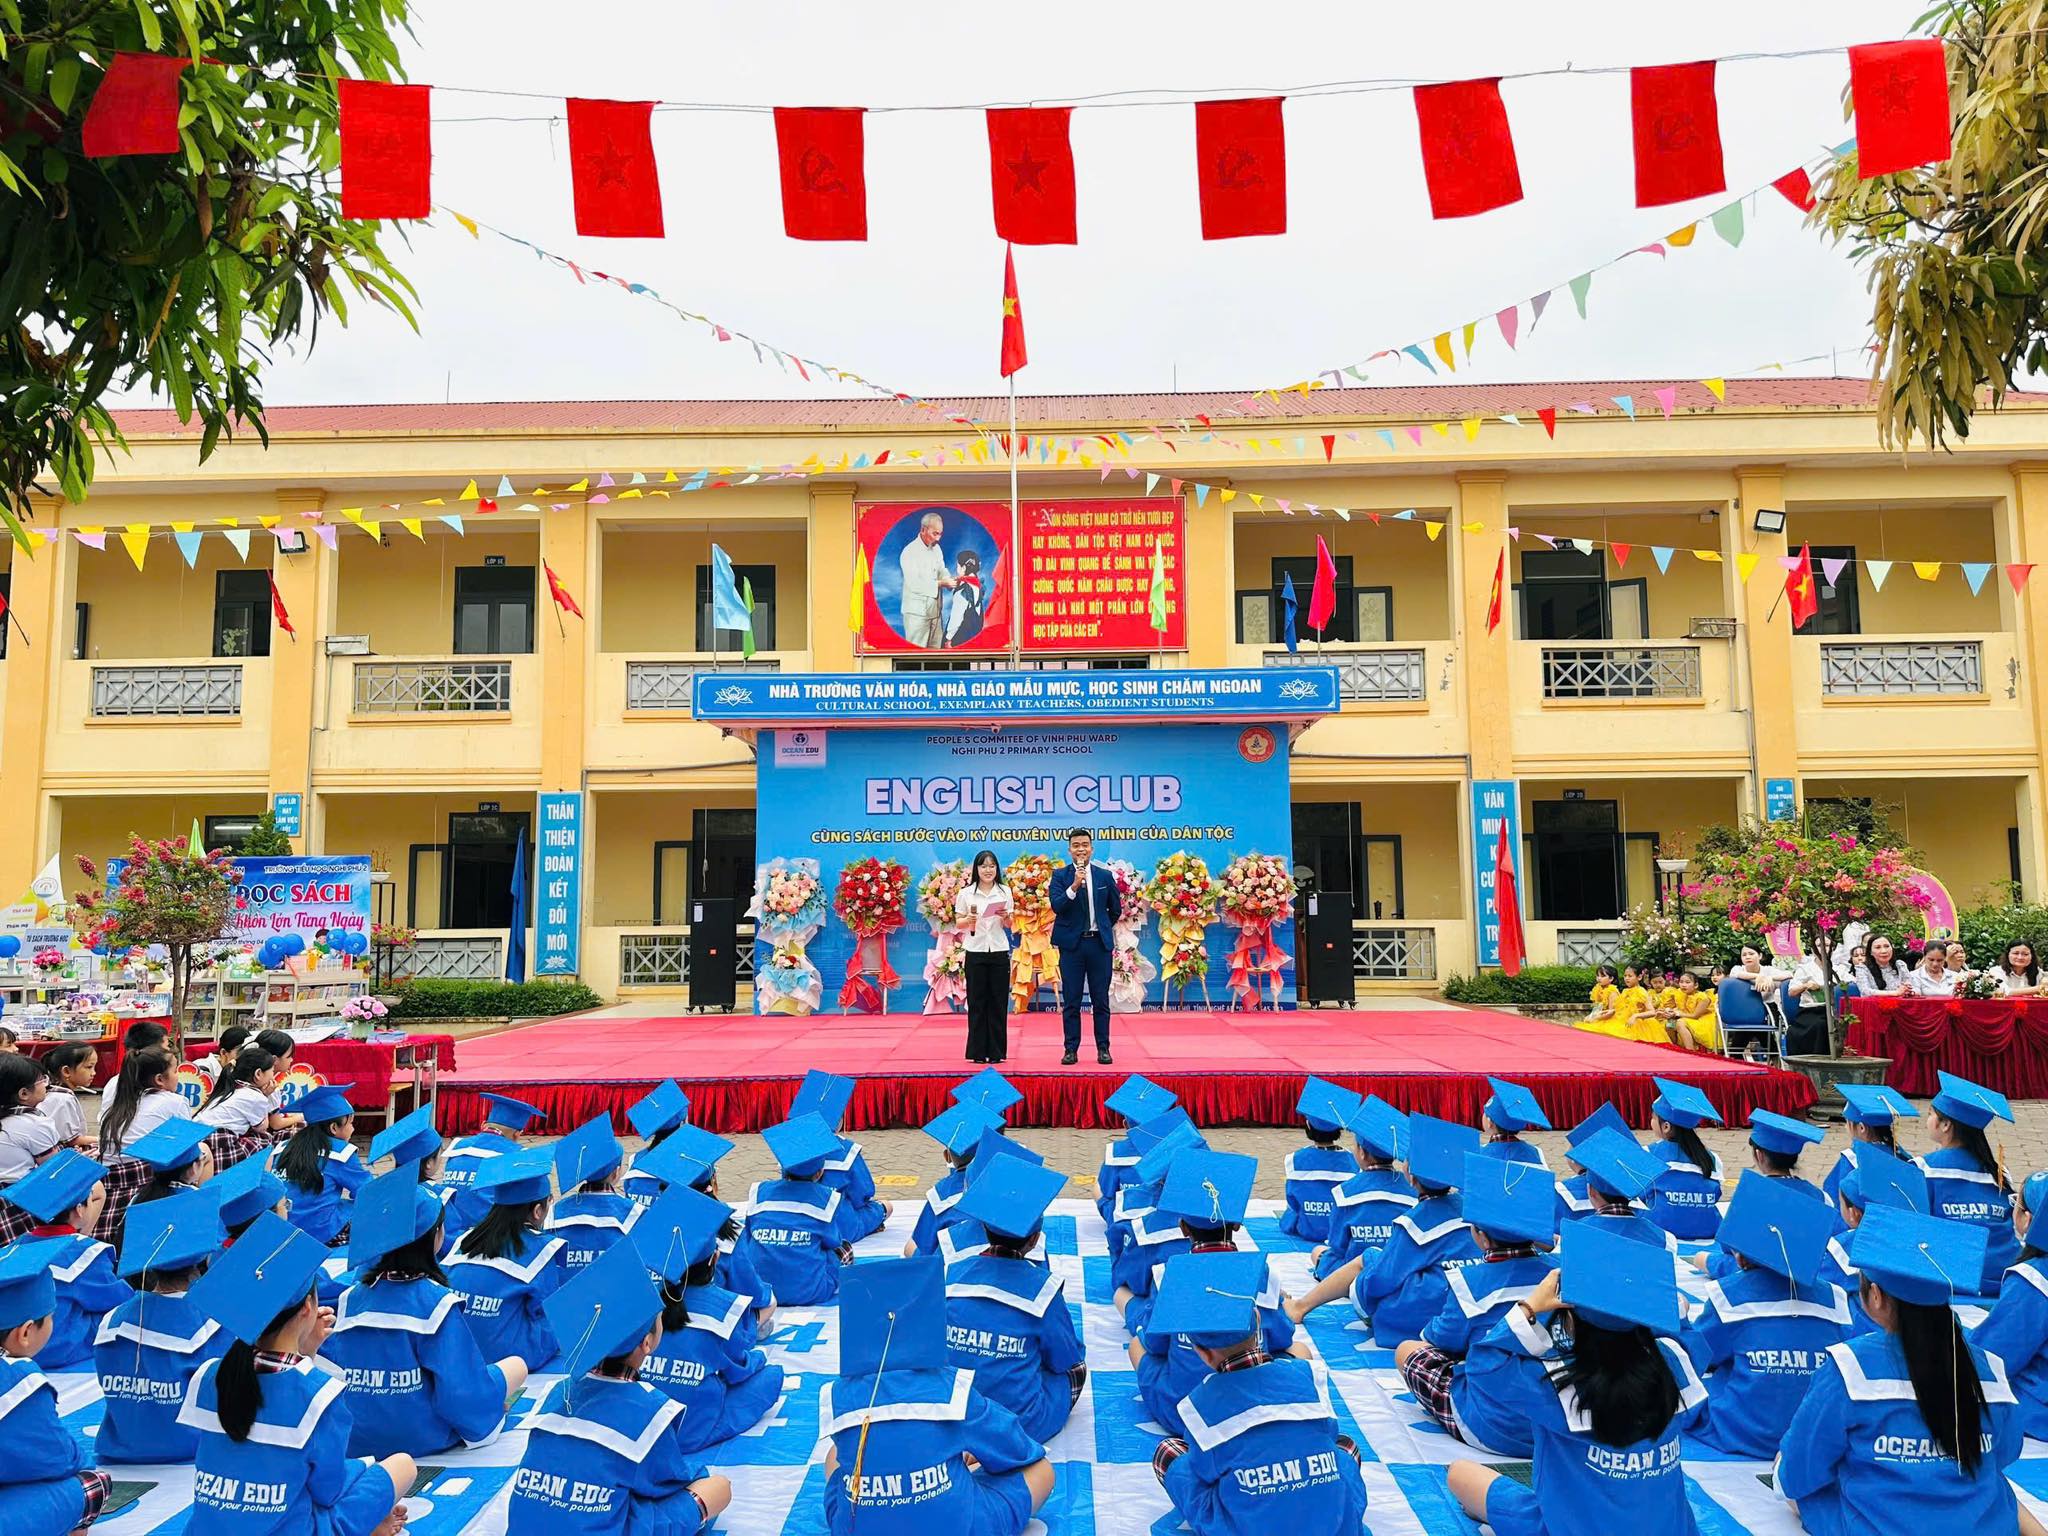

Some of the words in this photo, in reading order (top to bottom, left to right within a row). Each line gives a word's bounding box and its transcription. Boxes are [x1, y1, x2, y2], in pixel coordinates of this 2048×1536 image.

[1080, 510, 1093, 528] VIỆT
[1094, 512, 1109, 526] NAM
[1033, 535, 1045, 548] HAY
[1108, 533, 1122, 549] VIỆT
[1126, 534, 1141, 547] NAM
[1060, 557, 1075, 571] VINH
[1078, 556, 1099, 572] QUANG
[1135, 556, 1145, 569] VAI
[769, 681, 800, 698] NHÀ
[804, 681, 861, 698] TRƯỜNG
[865, 680, 895, 698] VĂN
[898, 681, 932, 699] HÓA,
[936, 680, 967, 697] NHÀ
[971, 680, 1004, 696] GIÁO
[1009, 678, 1042, 697] MẪU
[1047, 681, 1084, 700] MỰC,
[1088, 681, 1118, 699] HỌC
[1123, 681, 1158, 695] SINH
[1162, 678, 1205, 694] CHĂM
[1210, 679, 1261, 693] NGOAN
[816, 701, 881, 711] CULTURAL
[884, 701, 937, 711] SCHOOL,
[940, 700, 1013, 710] EXEMPLARY
[1017, 699, 1085, 709] TEACHERS,
[1087, 698, 1149, 708] OBEDIENT
[1151, 697, 1215, 707] STUDENTS
[927, 736, 971, 744] PEOPLE'S
[973, 735, 1024, 744] COMMITEE
[1026, 735, 1039, 743] OF
[1041, 734, 1065, 743] VINH
[1067, 734, 1086, 743] PHU
[1087, 734, 1118, 742] WARD
[951, 747, 976, 755] NGHI
[978, 746, 997, 755] PHU
[1000, 746, 1005, 754] 2
[1007, 746, 1051, 755] PRIMARY
[1052, 745, 1093, 754] SCHOOL
[865, 776, 1055, 815] ENGLISH
[1064, 775, 1183, 814] CLUB
[1483, 789, 1505, 808] VĂN
[547, 801, 575, 820] THÂN
[545, 827, 575, 849] THIỆN
[811, 828, 851, 843] CÙNG
[854, 828, 893, 843] SÁCH
[894, 827, 935, 842] BƯỚC
[937, 827, 966, 842] VÀO
[969, 826, 988, 841] KỶ
[991, 826, 1050, 841] NGUYÊN
[1097, 826, 1136, 840] MÌNH
[1139, 824, 1168, 840] CỦA
[1171, 825, 1203, 840] DÂN
[1205, 826, 1234, 843] TỘC
[545, 853, 573, 872] ĐOÀN
[236, 884, 284, 908] ĐỌC
[290, 880, 352, 904] SÁCH
[549, 877, 568, 898] KẾT
[330, 911, 365, 931] Ngày
[549, 903, 567, 924] ĐỔI
[547, 931, 567, 951] MỚI
[1304, 1201, 1333, 1213] OCEA
[1942, 1203, 1988, 1215] OCEAN
[1350, 1225, 1392, 1238] OCEAN
[472, 1294, 503, 1312] EDU
[997, 1335, 1026, 1353] EDU
[1746, 1350, 1807, 1368] OCEAN
[343, 1368, 385, 1387] CEAN
[390, 1367, 421, 1387] EDU
[670, 1359, 705, 1380] EDU
[1766, 1366, 1782, 1374] Turn
[102, 1375, 150, 1395] OCEAN
[150, 1380, 180, 1398] EDU
[910, 1462, 949, 1494] EDU
[1234, 1459, 1301, 1488] OCEAN
[1306, 1451, 1338, 1476] EDU
[1608, 1469, 1627, 1479] Turn
[1642, 1469, 1661, 1479] your
[242, 1482, 287, 1505] EDU
[517, 1467, 567, 1498] CEAN
[569, 1481, 615, 1504] EDU
[857, 1497, 874, 1506] Turn
[891, 1497, 912, 1507] your
[914, 1480, 953, 1504] potential
[1258, 1486, 1276, 1494] Turn
[1279, 1484, 1288, 1492] on
[1291, 1479, 1309, 1491] your
[209, 1498, 219, 1507] on
[220, 1501, 241, 1510] your
[242, 1504, 287, 1513] potential
[524, 1489, 539, 1499] Turn
[540, 1494, 549, 1502] on
[550, 1499, 568, 1509] your
[569, 1503, 612, 1512] potential
